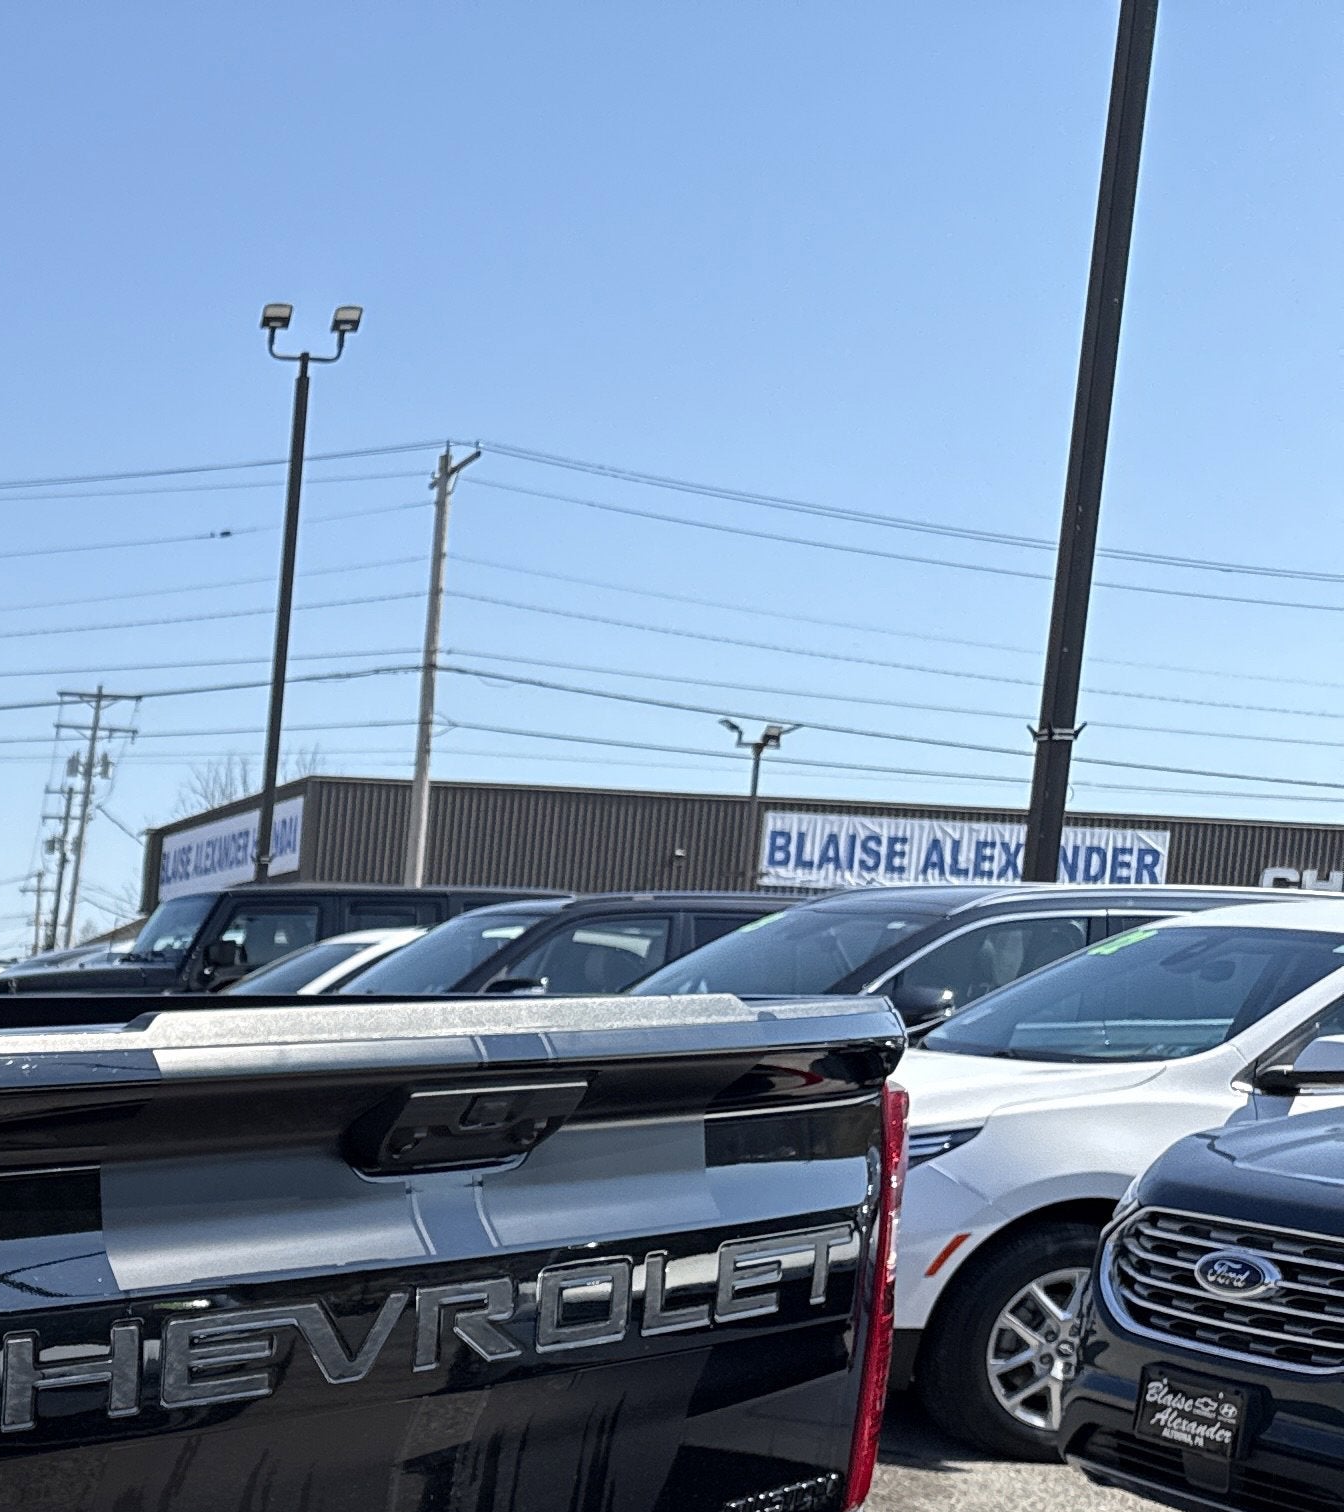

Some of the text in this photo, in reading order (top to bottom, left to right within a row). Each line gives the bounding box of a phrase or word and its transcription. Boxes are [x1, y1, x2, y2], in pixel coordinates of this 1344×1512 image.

[192, 829, 250, 877] ALEXANDER
[768, 829, 1161, 885] BLAISE ALEXNDER
[1207, 1259, 1250, 1288] Ford
[1146, 1381, 1193, 1412] Blaise
[1150, 1407, 1232, 1444] Alexander
